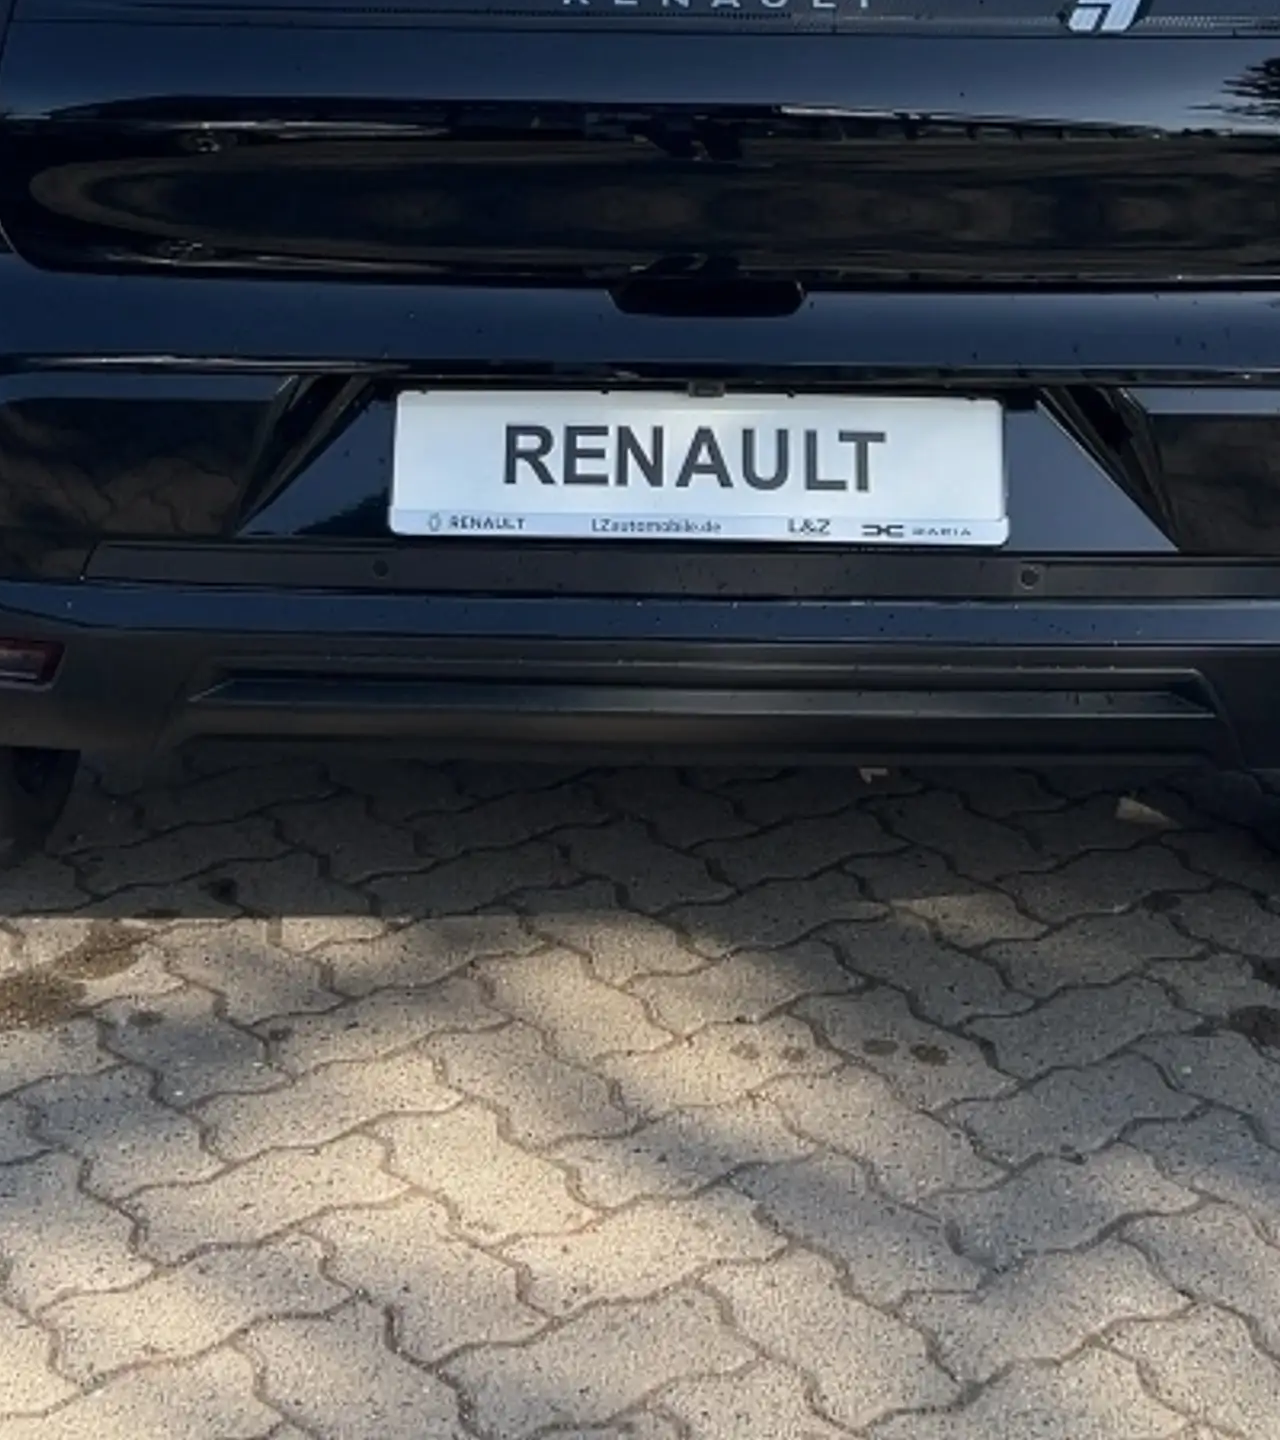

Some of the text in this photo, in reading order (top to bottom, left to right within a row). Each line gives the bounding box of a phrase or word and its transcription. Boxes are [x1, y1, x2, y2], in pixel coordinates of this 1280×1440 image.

[504, 424, 887, 492] RENAULT
[448, 515, 525, 530] RENAULT
[787, 518, 831, 536] L&Z
